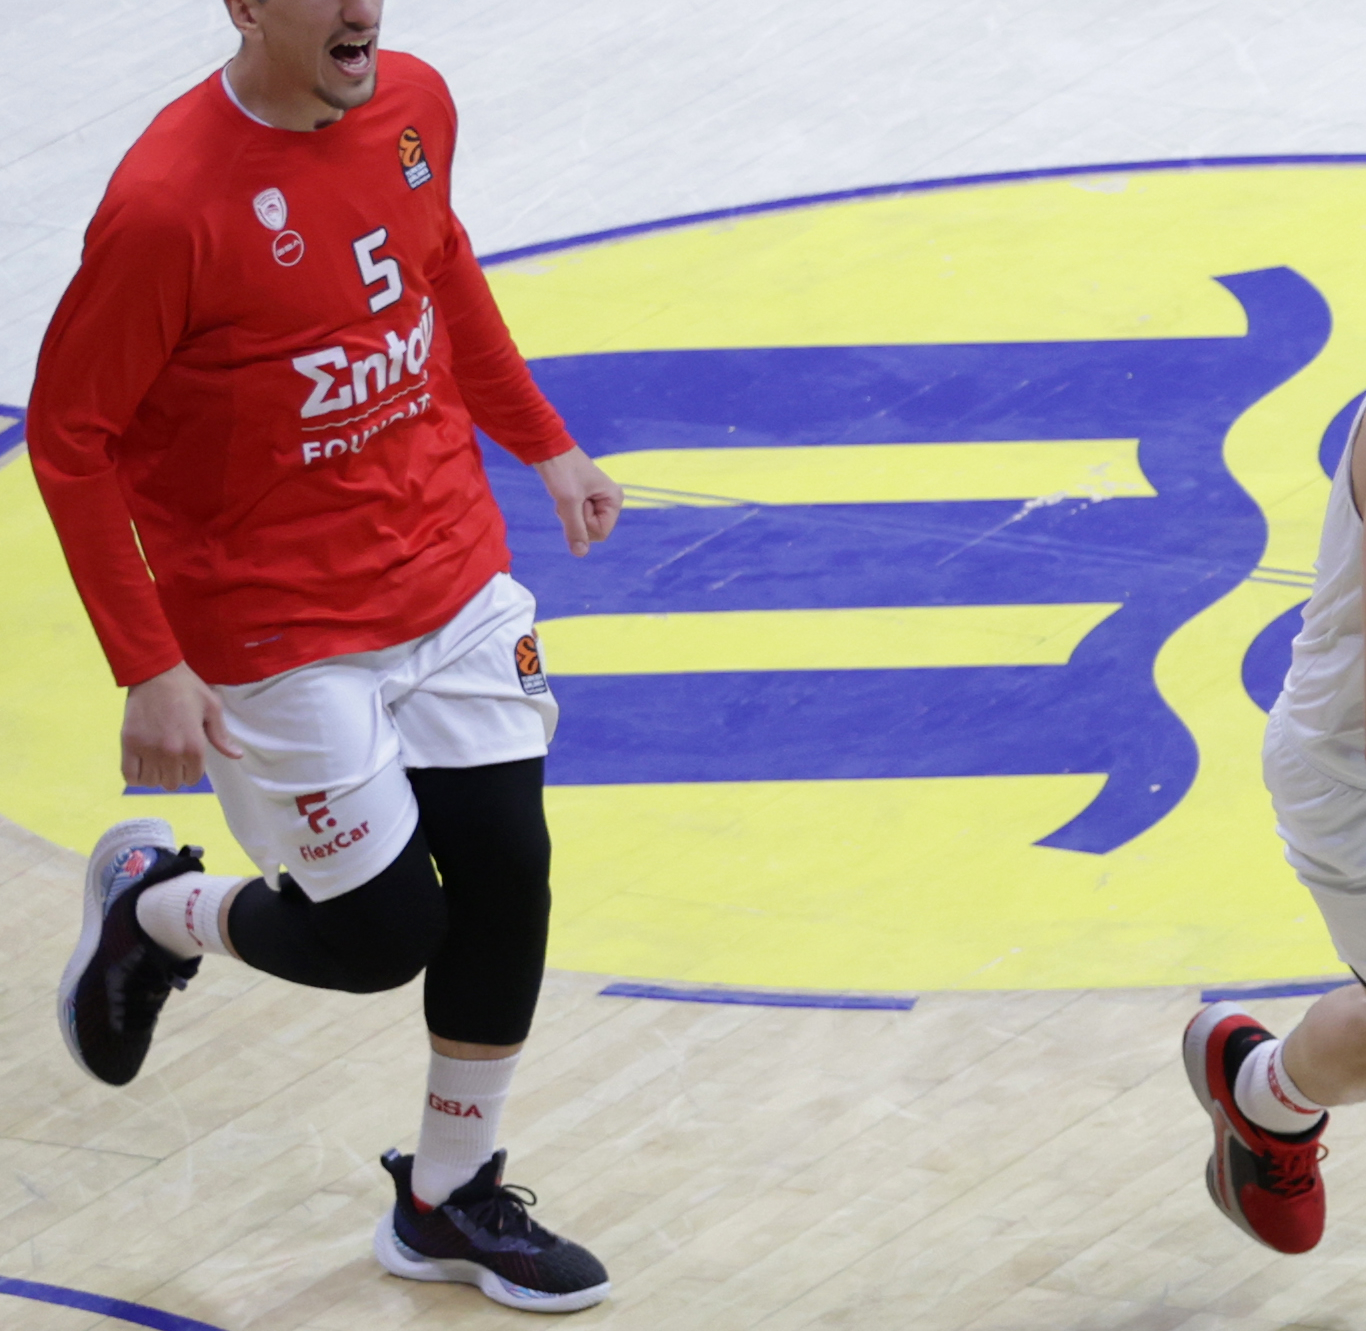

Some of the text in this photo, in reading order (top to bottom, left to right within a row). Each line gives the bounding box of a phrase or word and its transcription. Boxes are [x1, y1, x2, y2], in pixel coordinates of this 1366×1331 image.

[352, 226, 403, 314] 5
[299, 820, 370, 862] FlexCar
[429, 1093, 483, 1118] GSA
